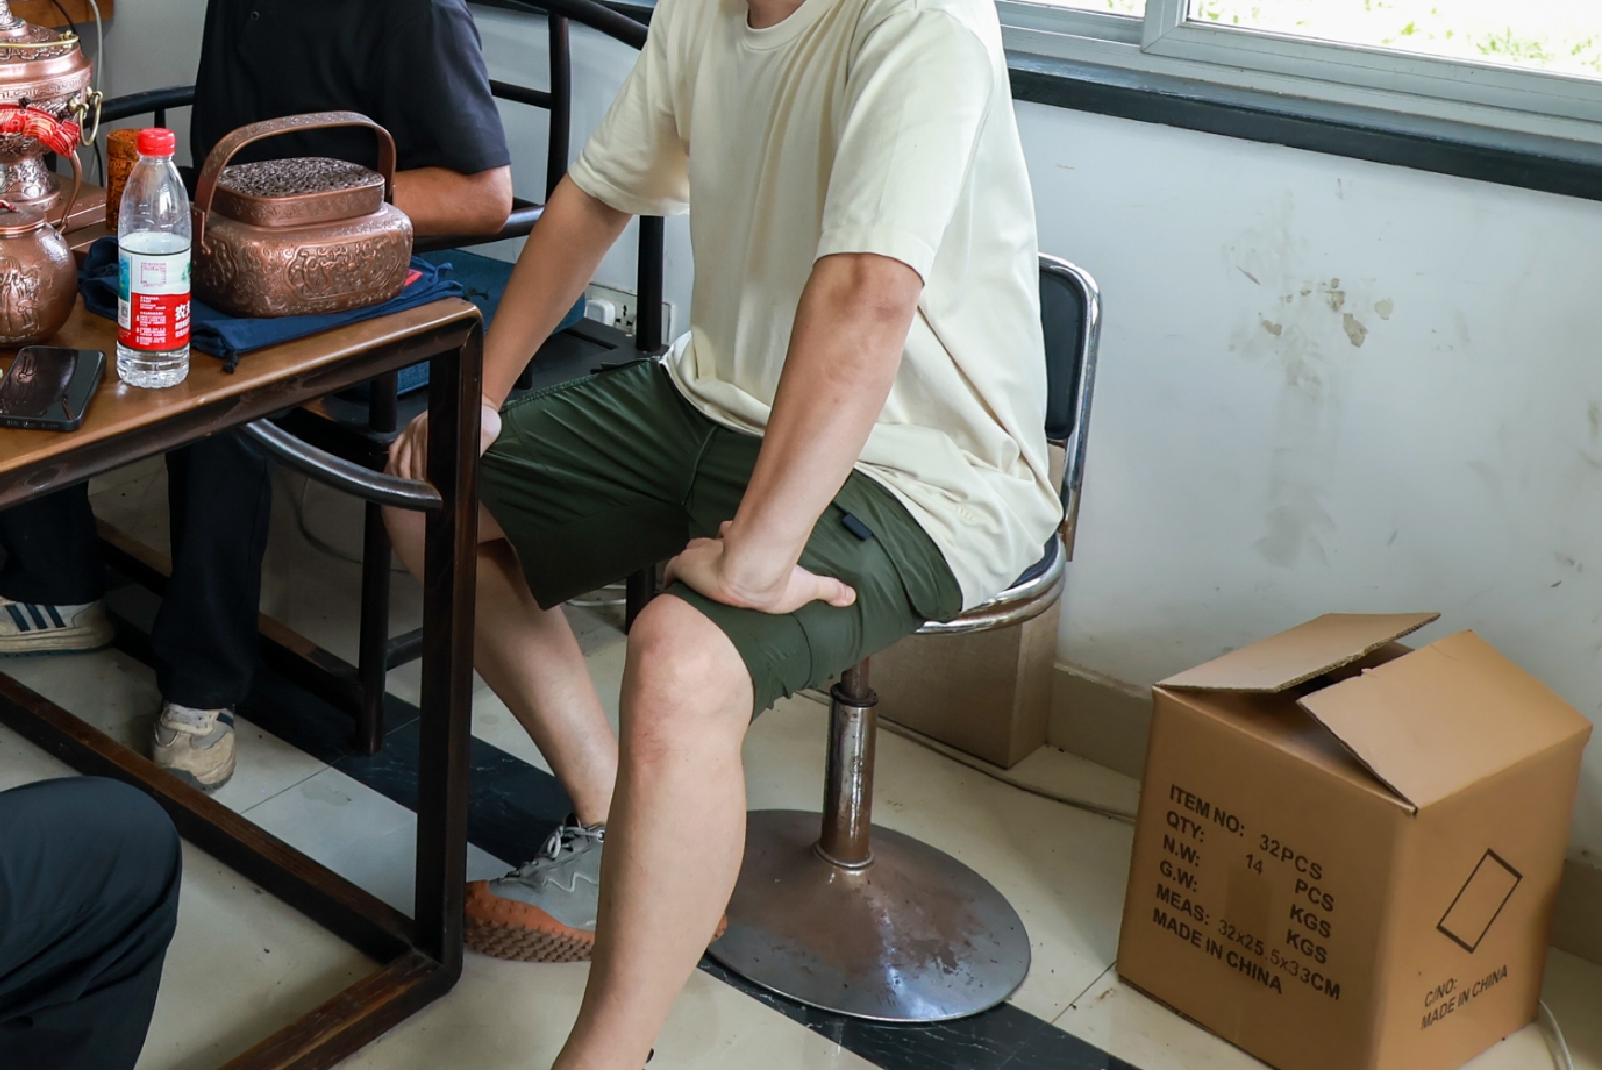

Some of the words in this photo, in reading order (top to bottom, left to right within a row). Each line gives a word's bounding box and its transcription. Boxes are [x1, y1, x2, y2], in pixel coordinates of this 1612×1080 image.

[1166, 810, 1204, 842] QTY:
[1246, 854, 1263, 875] 14
[1295, 878, 1334, 912] PCS
[1169, 784, 1210, 819] ITEM
[1213, 807, 1245, 837] NO:
[1259, 834, 1323, 880] 32PCS
[1156, 883, 1210, 926] MEAS:
[1159, 860, 1197, 892] G.W:
[1286, 928, 1328, 964] KGS
[1163, 834, 1200, 867] N.W:
[1289, 903, 1331, 938] KGS
[1152, 907, 1203, 948] MADE
[1205, 937, 1224, 961] IN
[1226, 950, 1283, 994] CHINA
[1421, 996, 1456, 1030] MADE
[1458, 987, 1471, 1008] IN
[1472, 964, 1508, 998] CHINA
